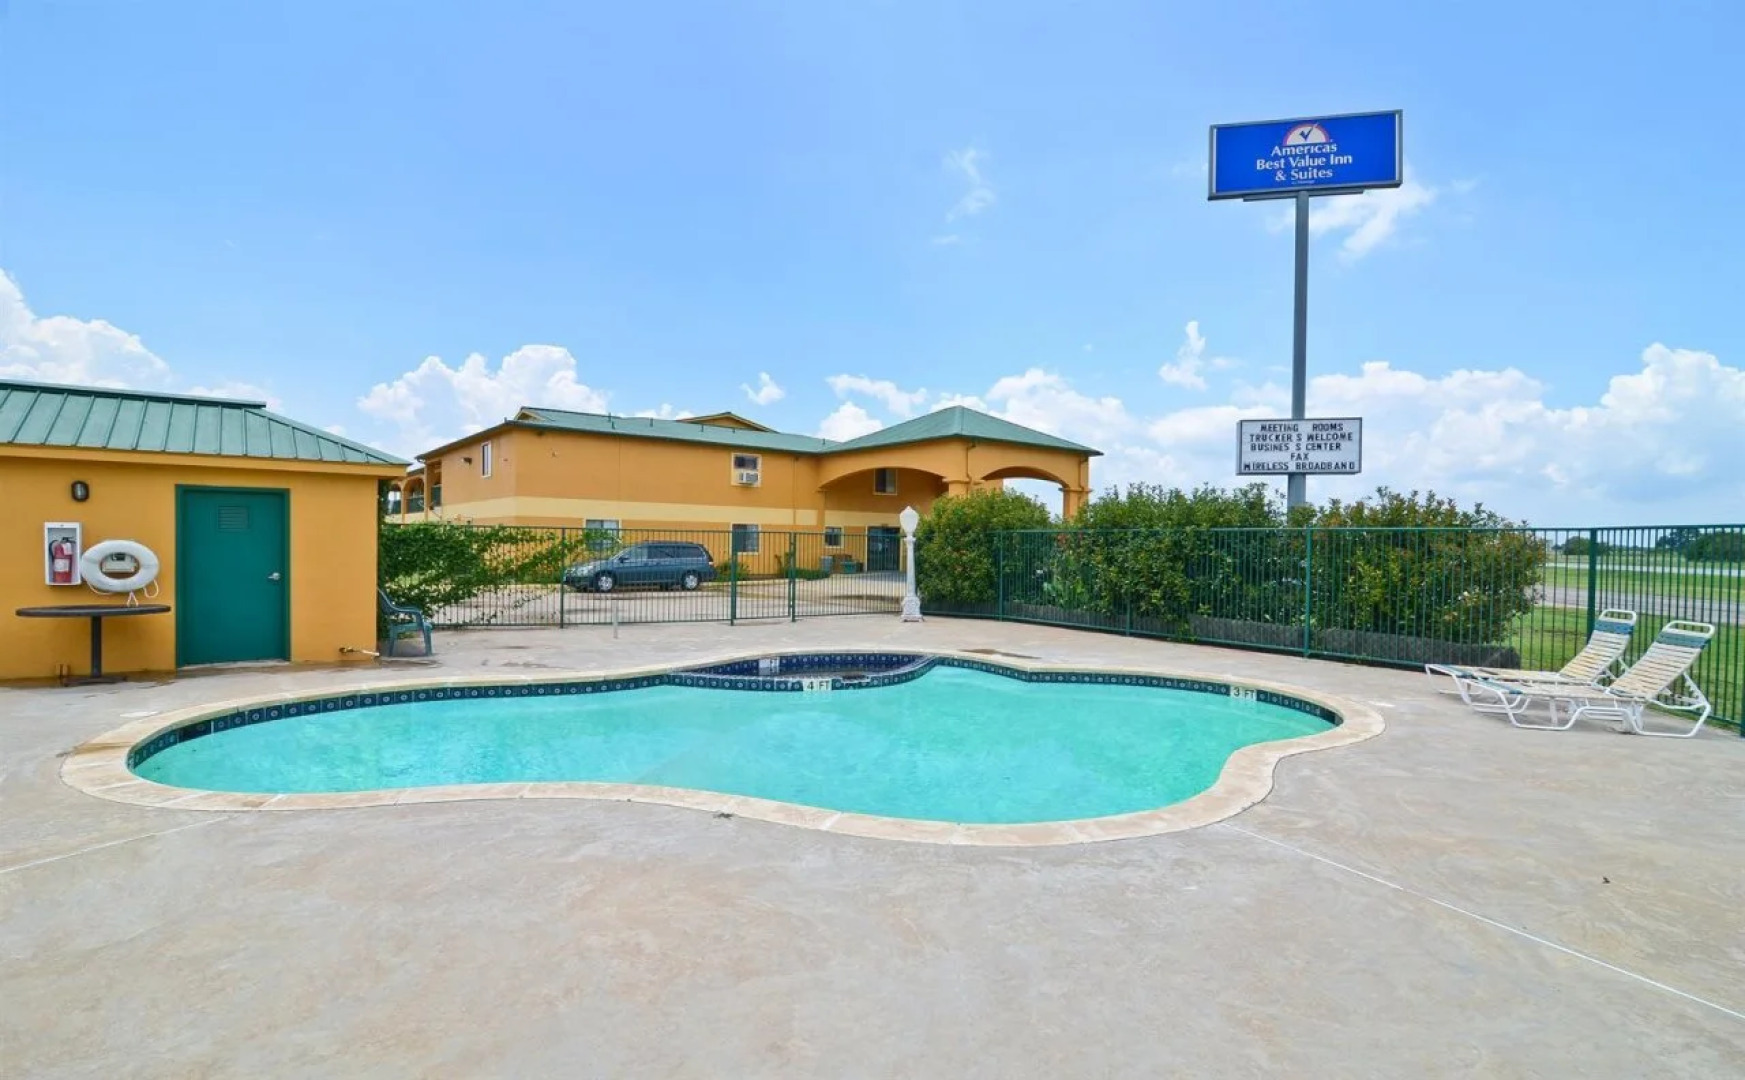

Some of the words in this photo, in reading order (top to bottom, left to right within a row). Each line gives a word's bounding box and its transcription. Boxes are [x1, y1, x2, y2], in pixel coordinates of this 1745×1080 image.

[1271, 142, 1337, 156] Americas
[1256, 158, 1285, 170] Best
[1289, 155, 1326, 168] Value
[1330, 154, 1353, 165] Inn
[1275, 170, 1286, 181] &
[1290, 168, 1333, 180] Suites
[1260, 424, 1299, 432] MEETING
[1312, 423, 1343, 431] ROOMS
[1307, 432, 1353, 441] WELCOME
[1306, 443, 1341, 451] CENTER
[1291, 453, 1309, 461] FAX
[1243, 462, 1289, 471] WIRELESS
[1296, 462, 1355, 470] BROADBAND
[806, 681, 814, 690] 4
[819, 680, 830, 690] FT
[1233, 686, 1240, 697] 3
[1245, 690, 1254, 698] FT
